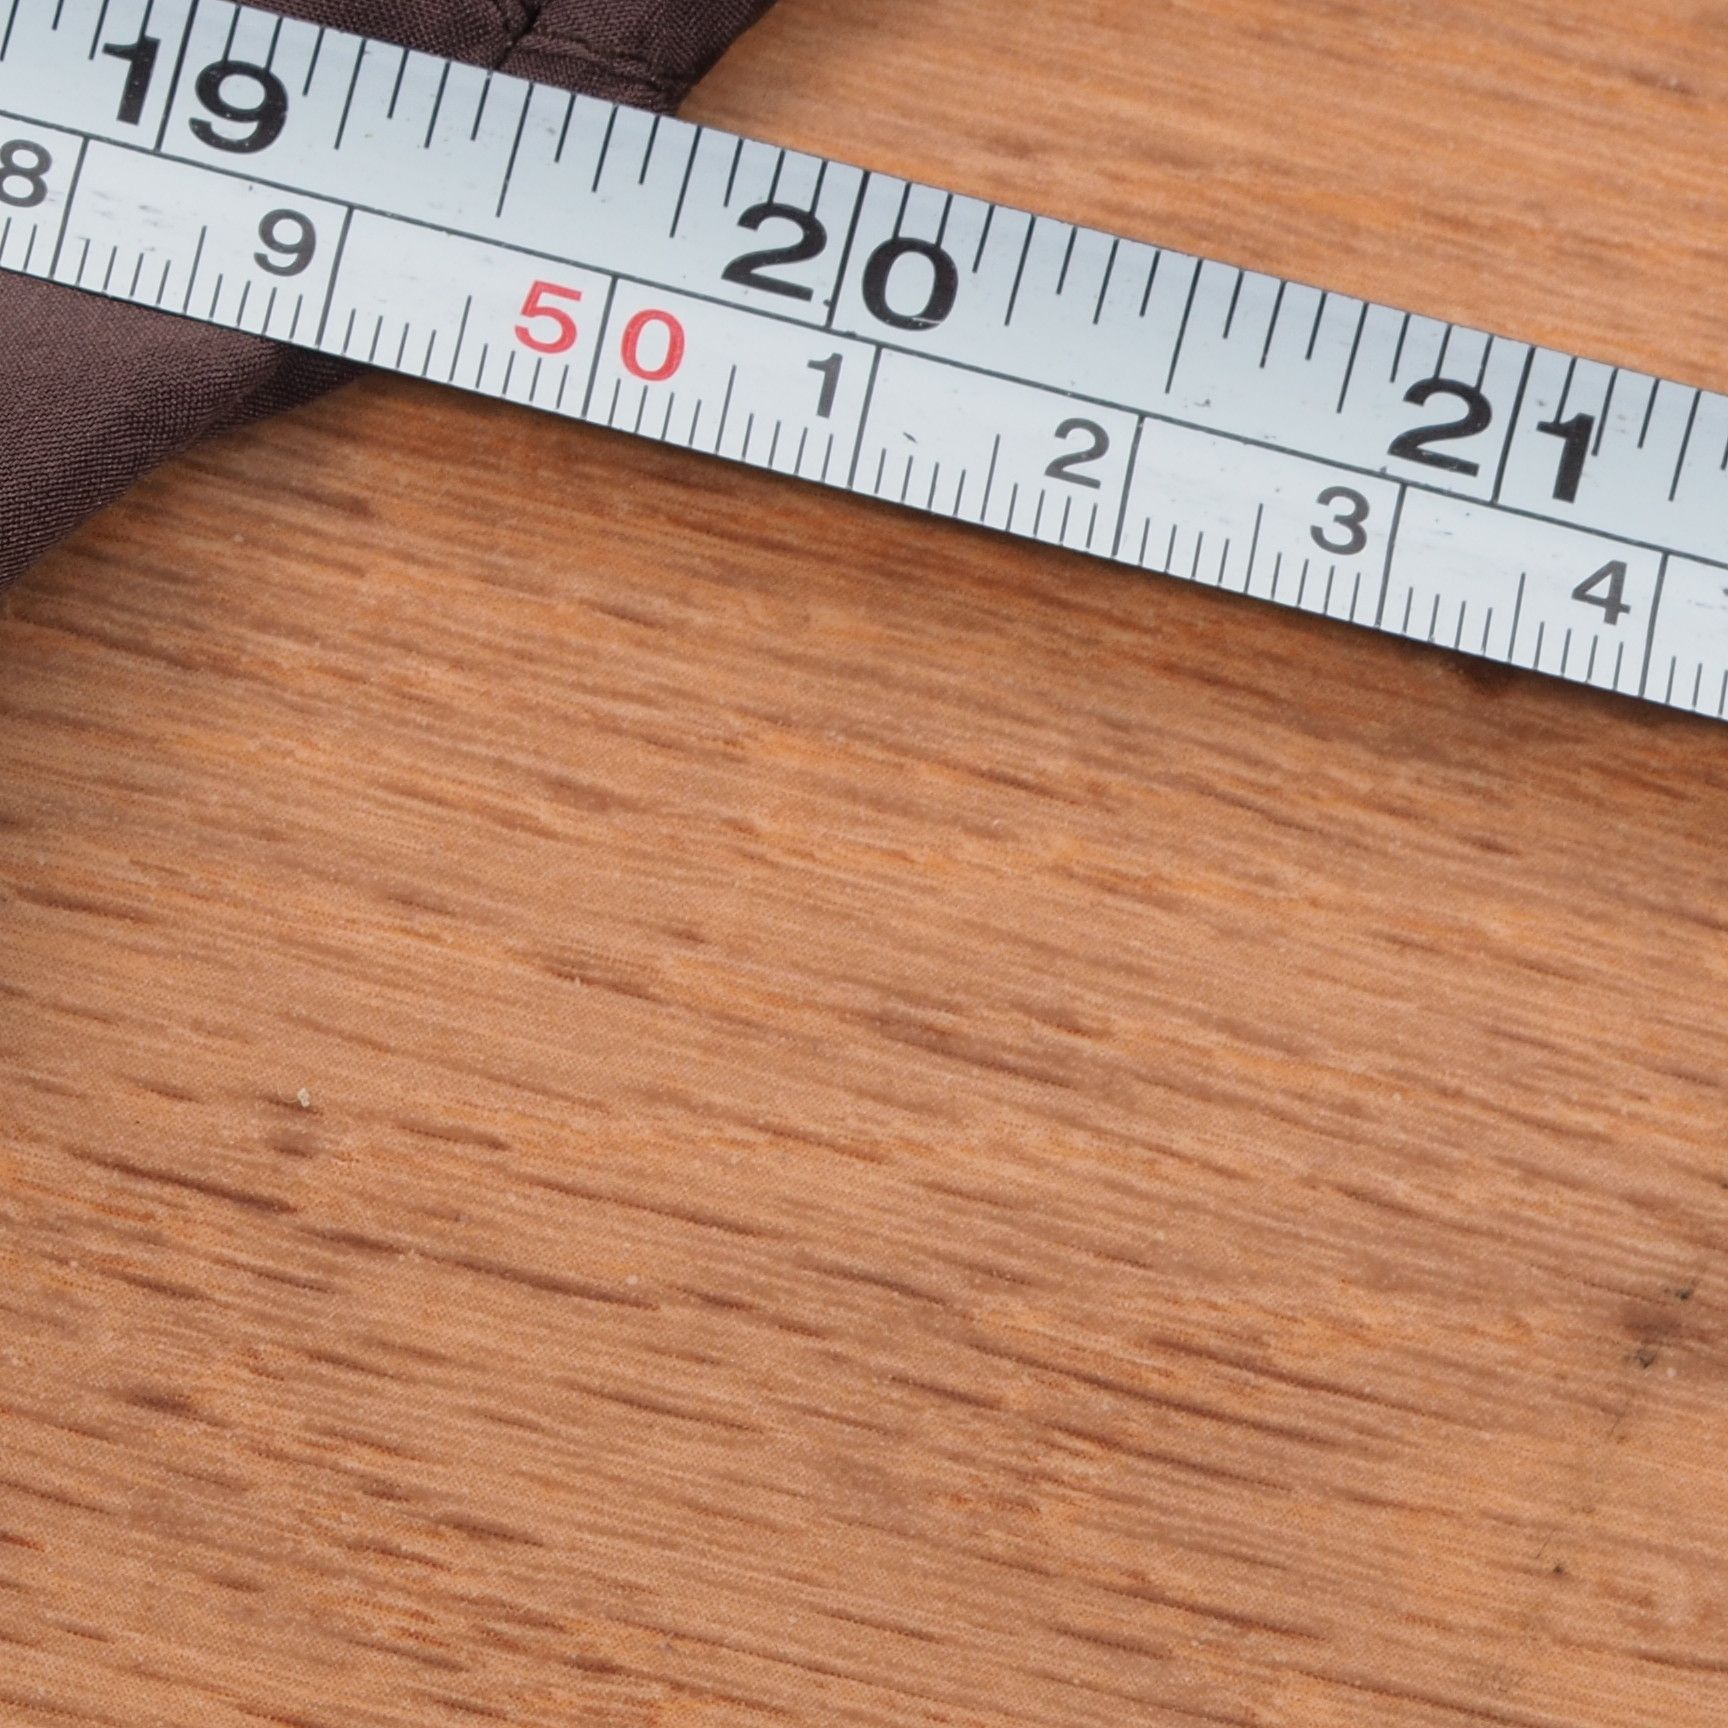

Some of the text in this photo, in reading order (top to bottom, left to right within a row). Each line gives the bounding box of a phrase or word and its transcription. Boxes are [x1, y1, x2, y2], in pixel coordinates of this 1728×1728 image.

[103, 34, 290, 154] 19
[721, 202, 959, 331] 20
[1387, 377, 1596, 504] 21
[253, 209, 317, 277] 9
[514, 280, 686, 382] 50
[806, 352, 844, 419] 1
[1044, 418, 1110, 490] 2
[1310, 486, 1370, 556] 3
[1571, 559, 1631, 626] 4
